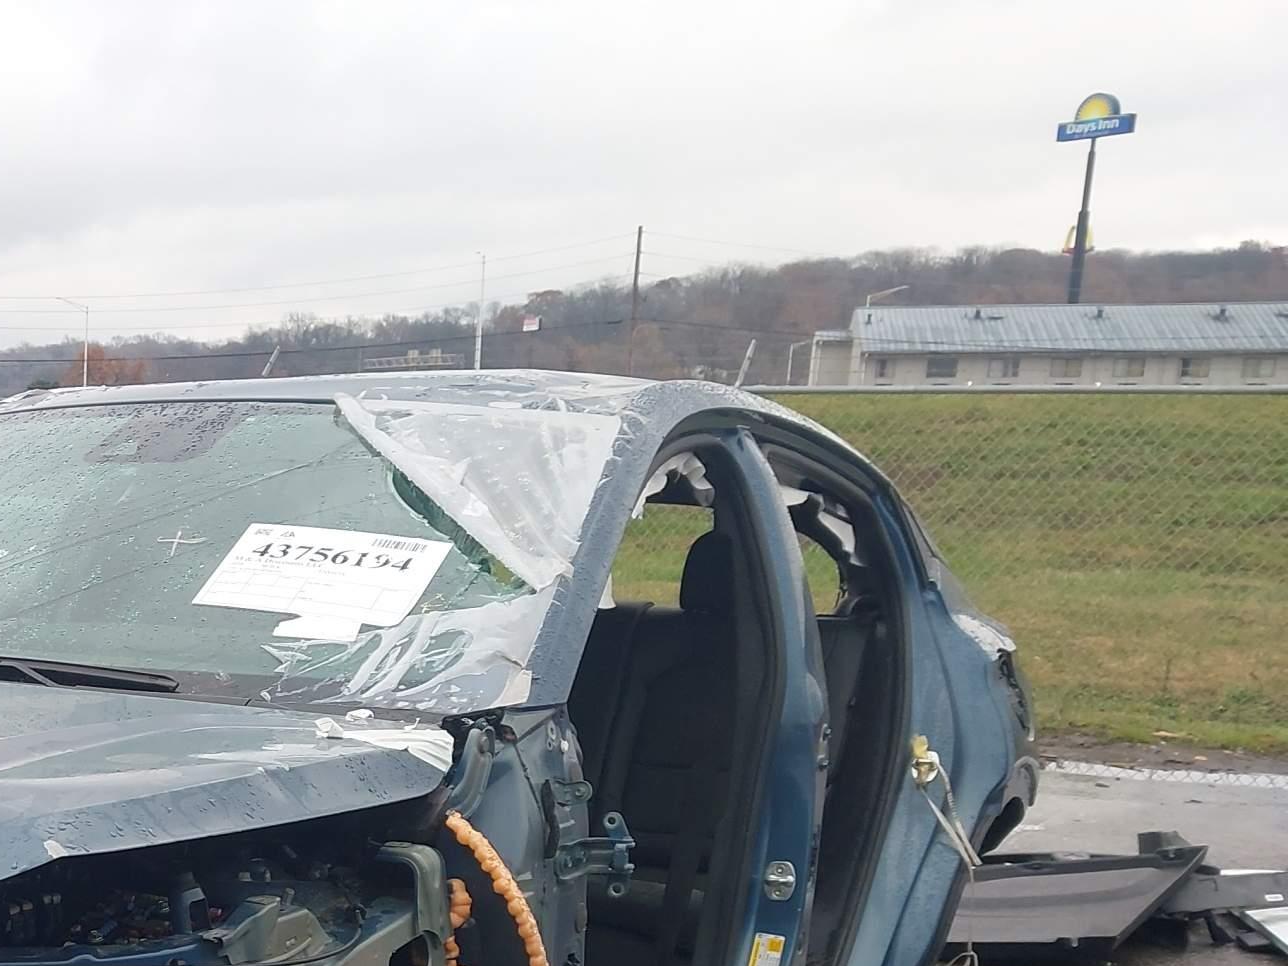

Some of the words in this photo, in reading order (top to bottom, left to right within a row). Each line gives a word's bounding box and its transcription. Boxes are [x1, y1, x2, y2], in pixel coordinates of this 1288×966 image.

[1066, 122, 1097, 134] Days
[1098, 119, 1120, 130] Inn
[252, 542, 414, 571] 43756194
